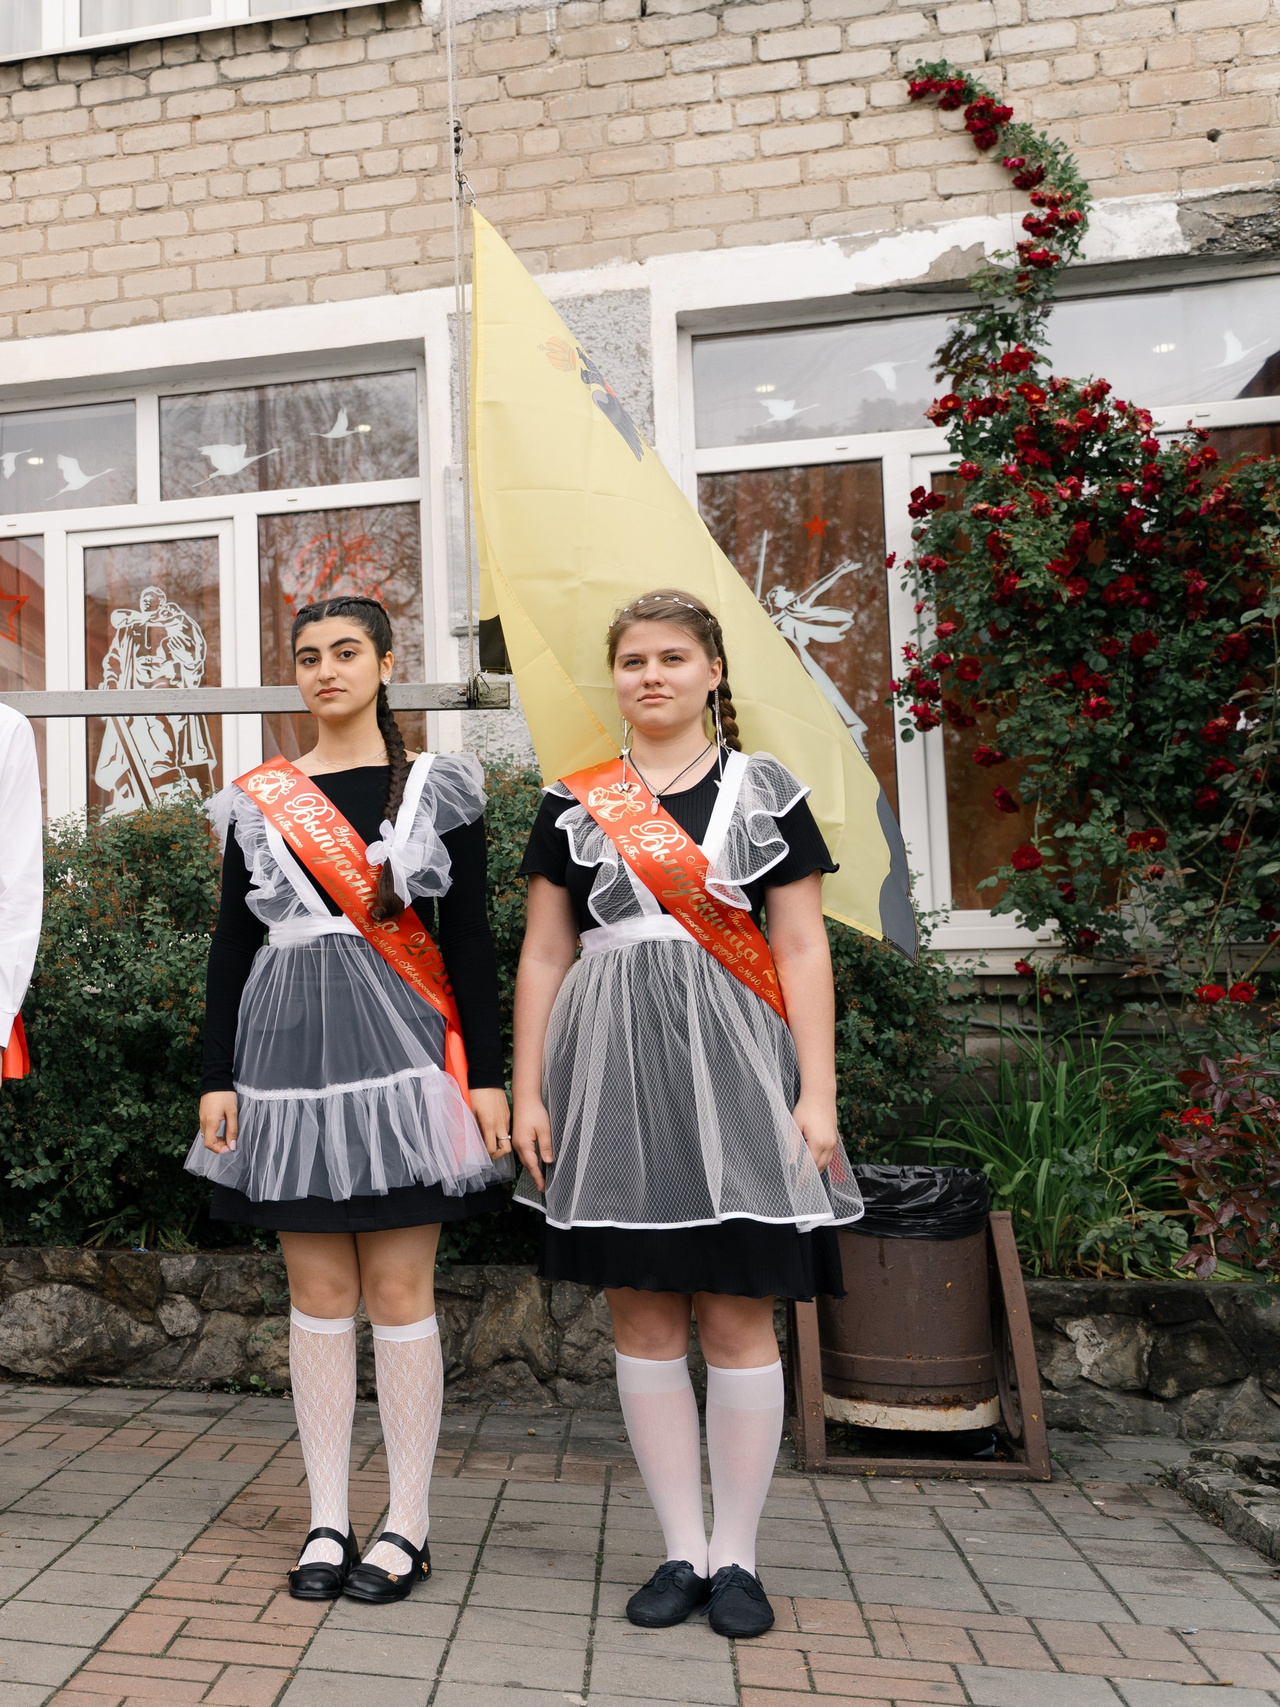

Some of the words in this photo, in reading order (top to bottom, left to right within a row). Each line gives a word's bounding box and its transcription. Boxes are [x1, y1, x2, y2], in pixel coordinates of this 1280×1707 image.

[284, 792, 400, 934] Выпускниа
[401, 931, 454, 998] 2026
[629, 820, 759, 965] Выпускница
[728, 909, 753, 940] Полина
[712, 941, 739, 966] СОШ
